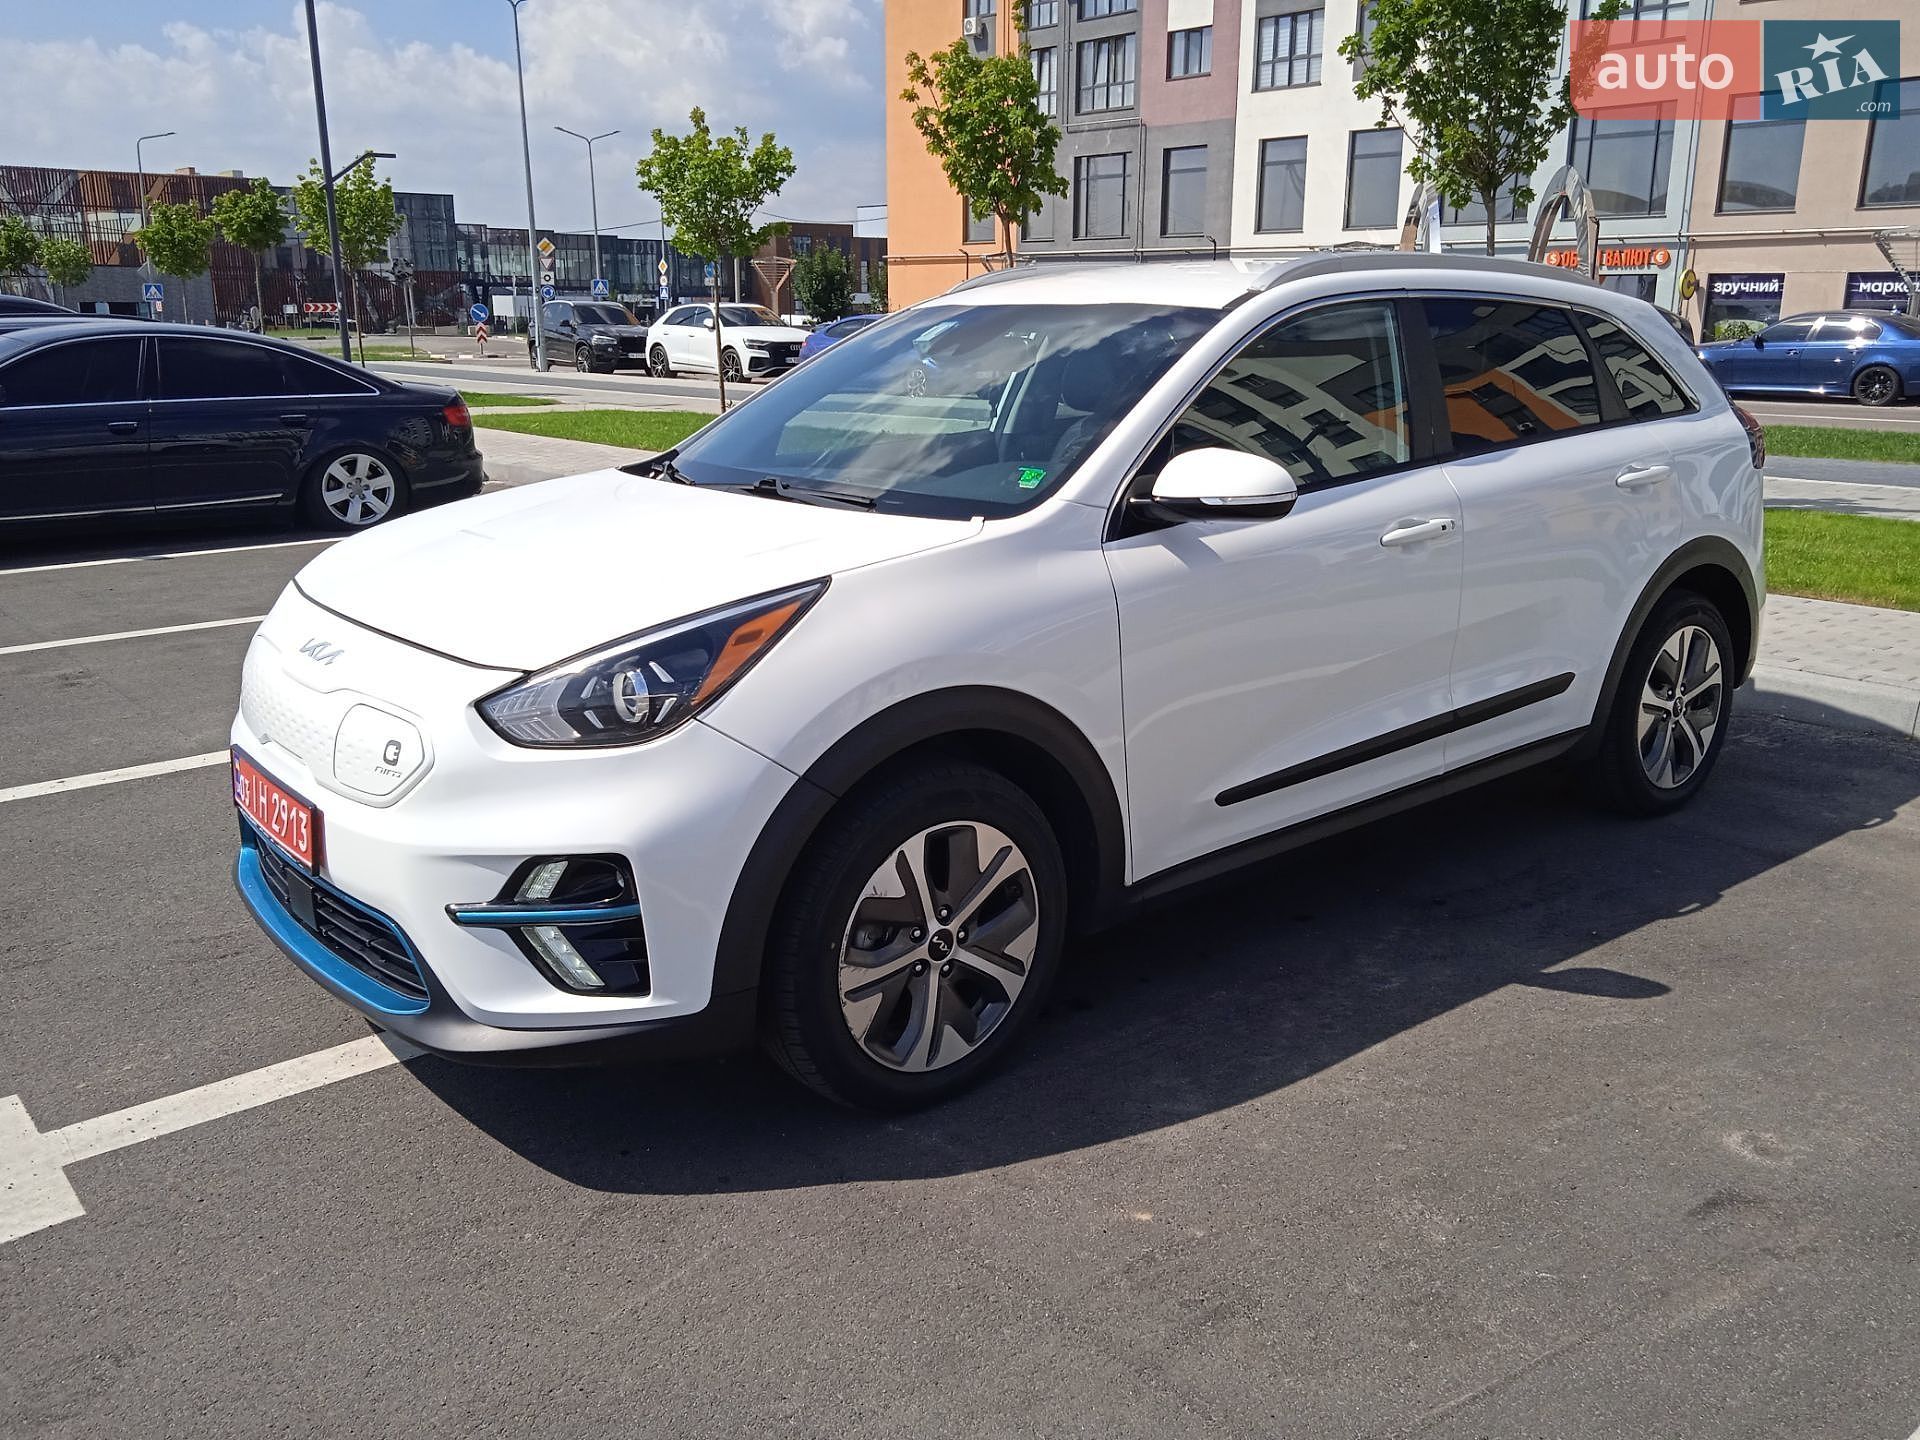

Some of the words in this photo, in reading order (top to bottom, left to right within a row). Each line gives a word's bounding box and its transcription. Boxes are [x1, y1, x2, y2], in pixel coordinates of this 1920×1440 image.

[1713, 279, 1779, 295] зручний
[299, 637, 345, 666] KIA
[239, 774, 250, 807] 03
[271, 792, 308, 852] 2913
